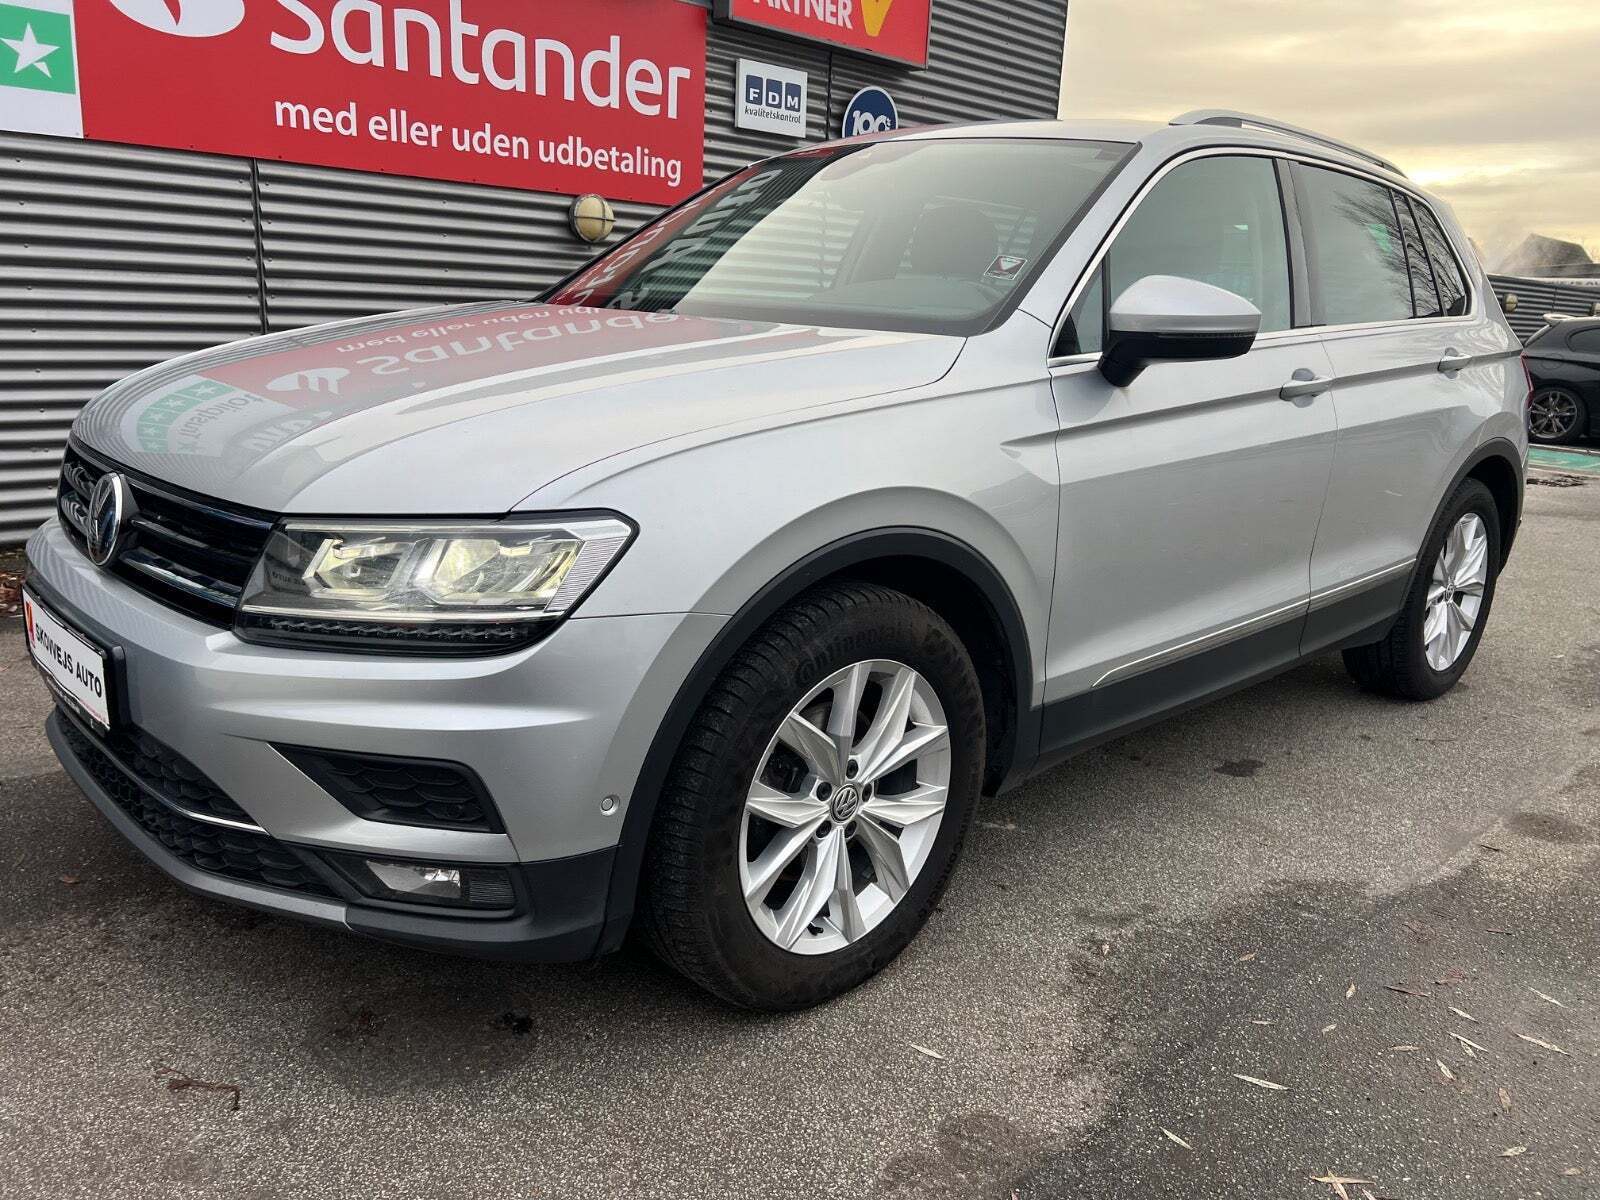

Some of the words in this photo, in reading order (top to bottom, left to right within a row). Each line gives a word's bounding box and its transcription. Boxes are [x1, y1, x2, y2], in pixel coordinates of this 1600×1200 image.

[270, 0, 691, 119] Santander
[744, 105, 801, 124] kvalitetskontrol
[749, 87, 799, 109] FDM
[274, 101, 357, 137] med
[368, 108, 443, 147] eller
[451, 123, 529, 160] uden
[538, 136, 682, 187] udbetaling
[76, 661, 102, 698] AUTO
